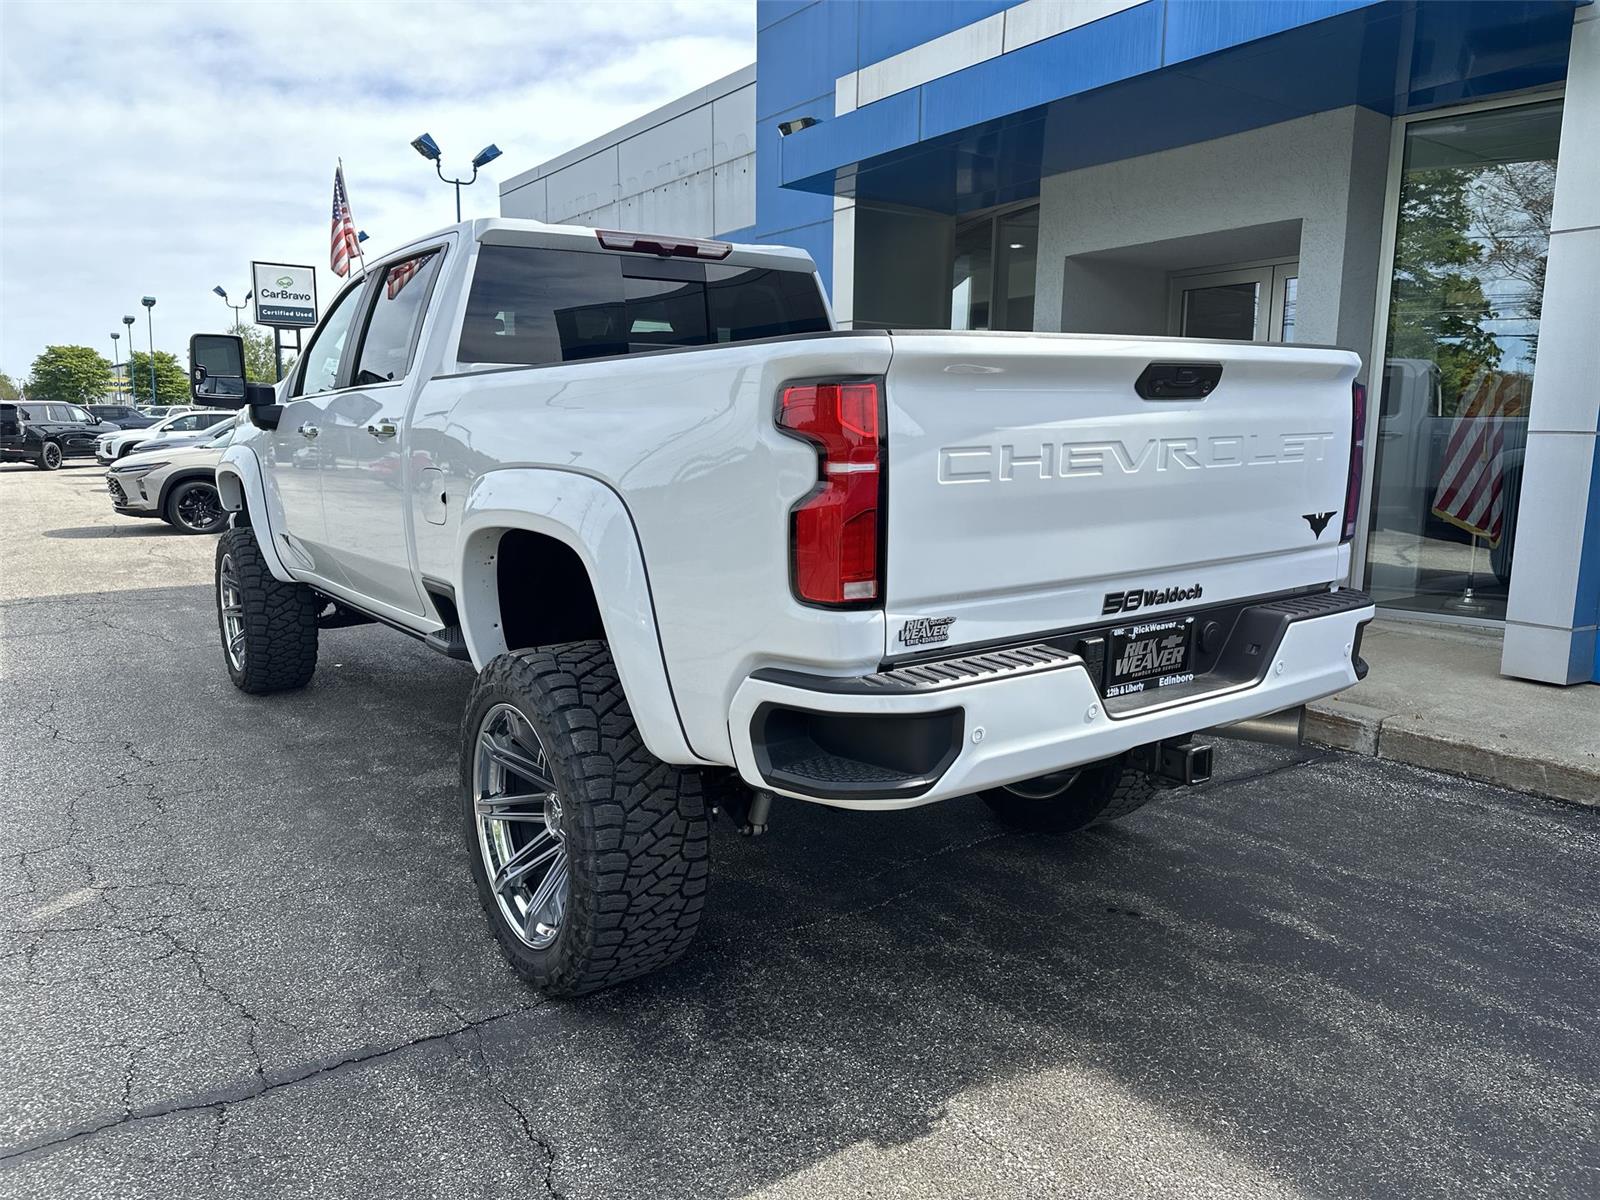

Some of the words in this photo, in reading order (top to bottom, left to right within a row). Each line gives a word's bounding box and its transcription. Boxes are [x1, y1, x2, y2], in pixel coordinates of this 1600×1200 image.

[261, 288, 311, 301] CarBravo
[262, 309, 294, 317] Certified
[937, 431, 1334, 485] CHEVROLET
[1143, 583, 1203, 607] Waldoch
[900, 624, 948, 641] WEAVER
[905, 618, 932, 631] RICK
[1133, 621, 1177, 635] RickWeaver
[1124, 638, 1160, 659] RICK
[1115, 646, 1185, 677] WEAVER
[1159, 673, 1194, 687] Edinboro
[1106, 687, 1120, 698] 12th
[1125, 682, 1145, 694] Liberty
